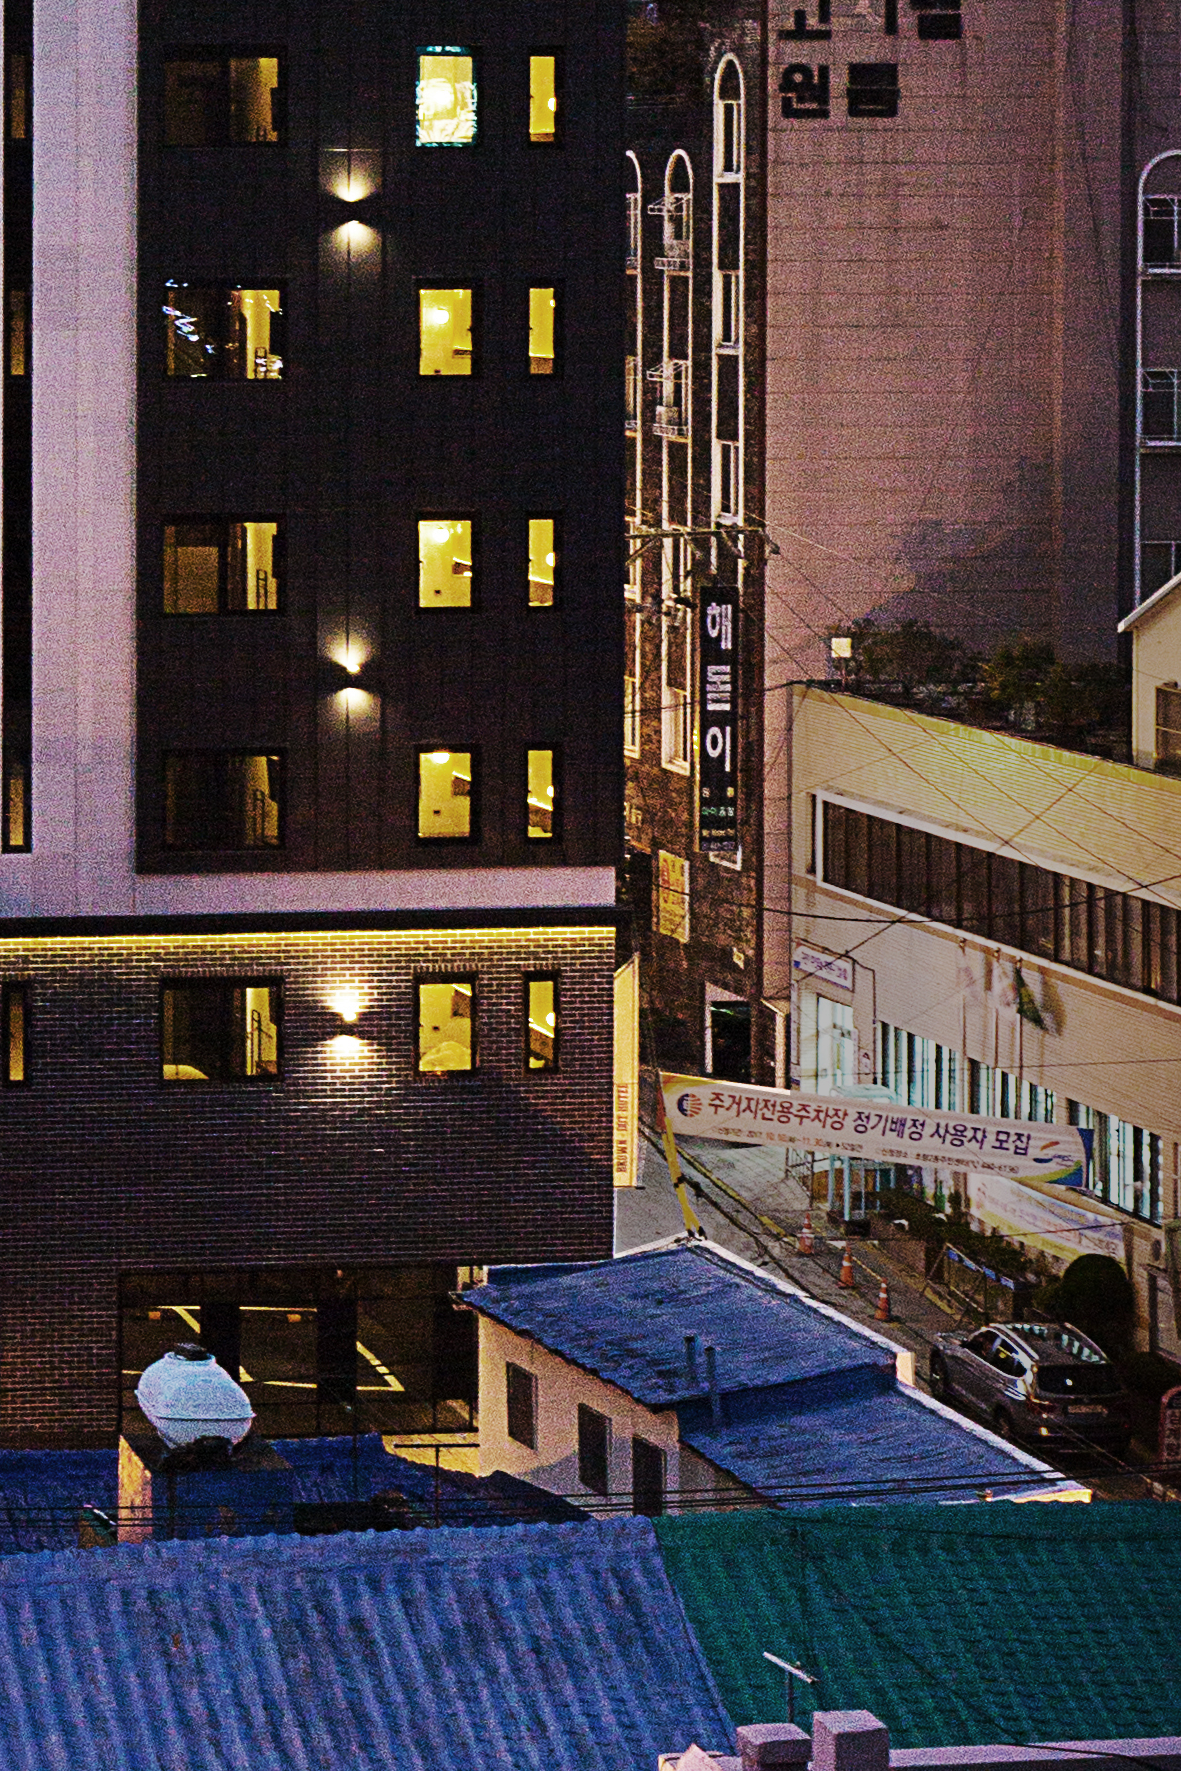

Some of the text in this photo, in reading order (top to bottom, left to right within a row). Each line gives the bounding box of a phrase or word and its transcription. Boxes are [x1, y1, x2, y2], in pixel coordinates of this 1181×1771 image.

[708, 1092, 1032, 1157] 주거지전용주차장 정기배정 사용자 모집
